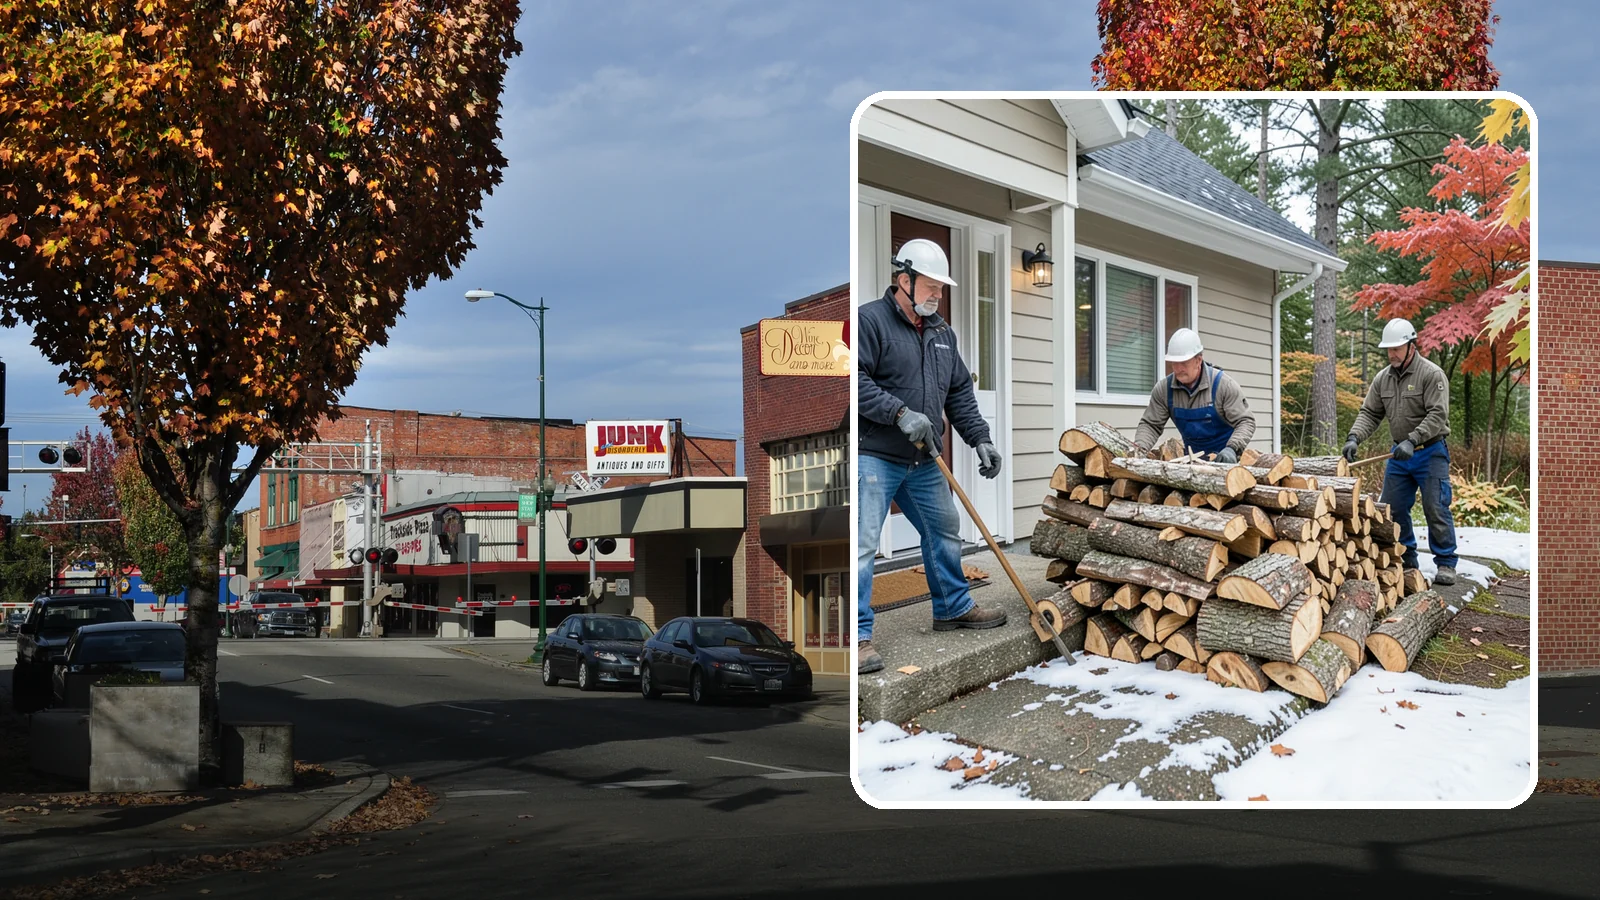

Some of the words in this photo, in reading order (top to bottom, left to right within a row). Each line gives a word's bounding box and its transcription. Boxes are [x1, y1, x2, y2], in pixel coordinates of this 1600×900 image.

[765, 327, 831, 365] Decor
[596, 425, 664, 457] JUNK
[597, 461, 628, 470] ANTIQUES
[631, 461, 644, 470] AND
[647, 460, 665, 469] GIFTS
[390, 521, 413, 539] Trackside
[414, 519, 429, 535] Pizza
